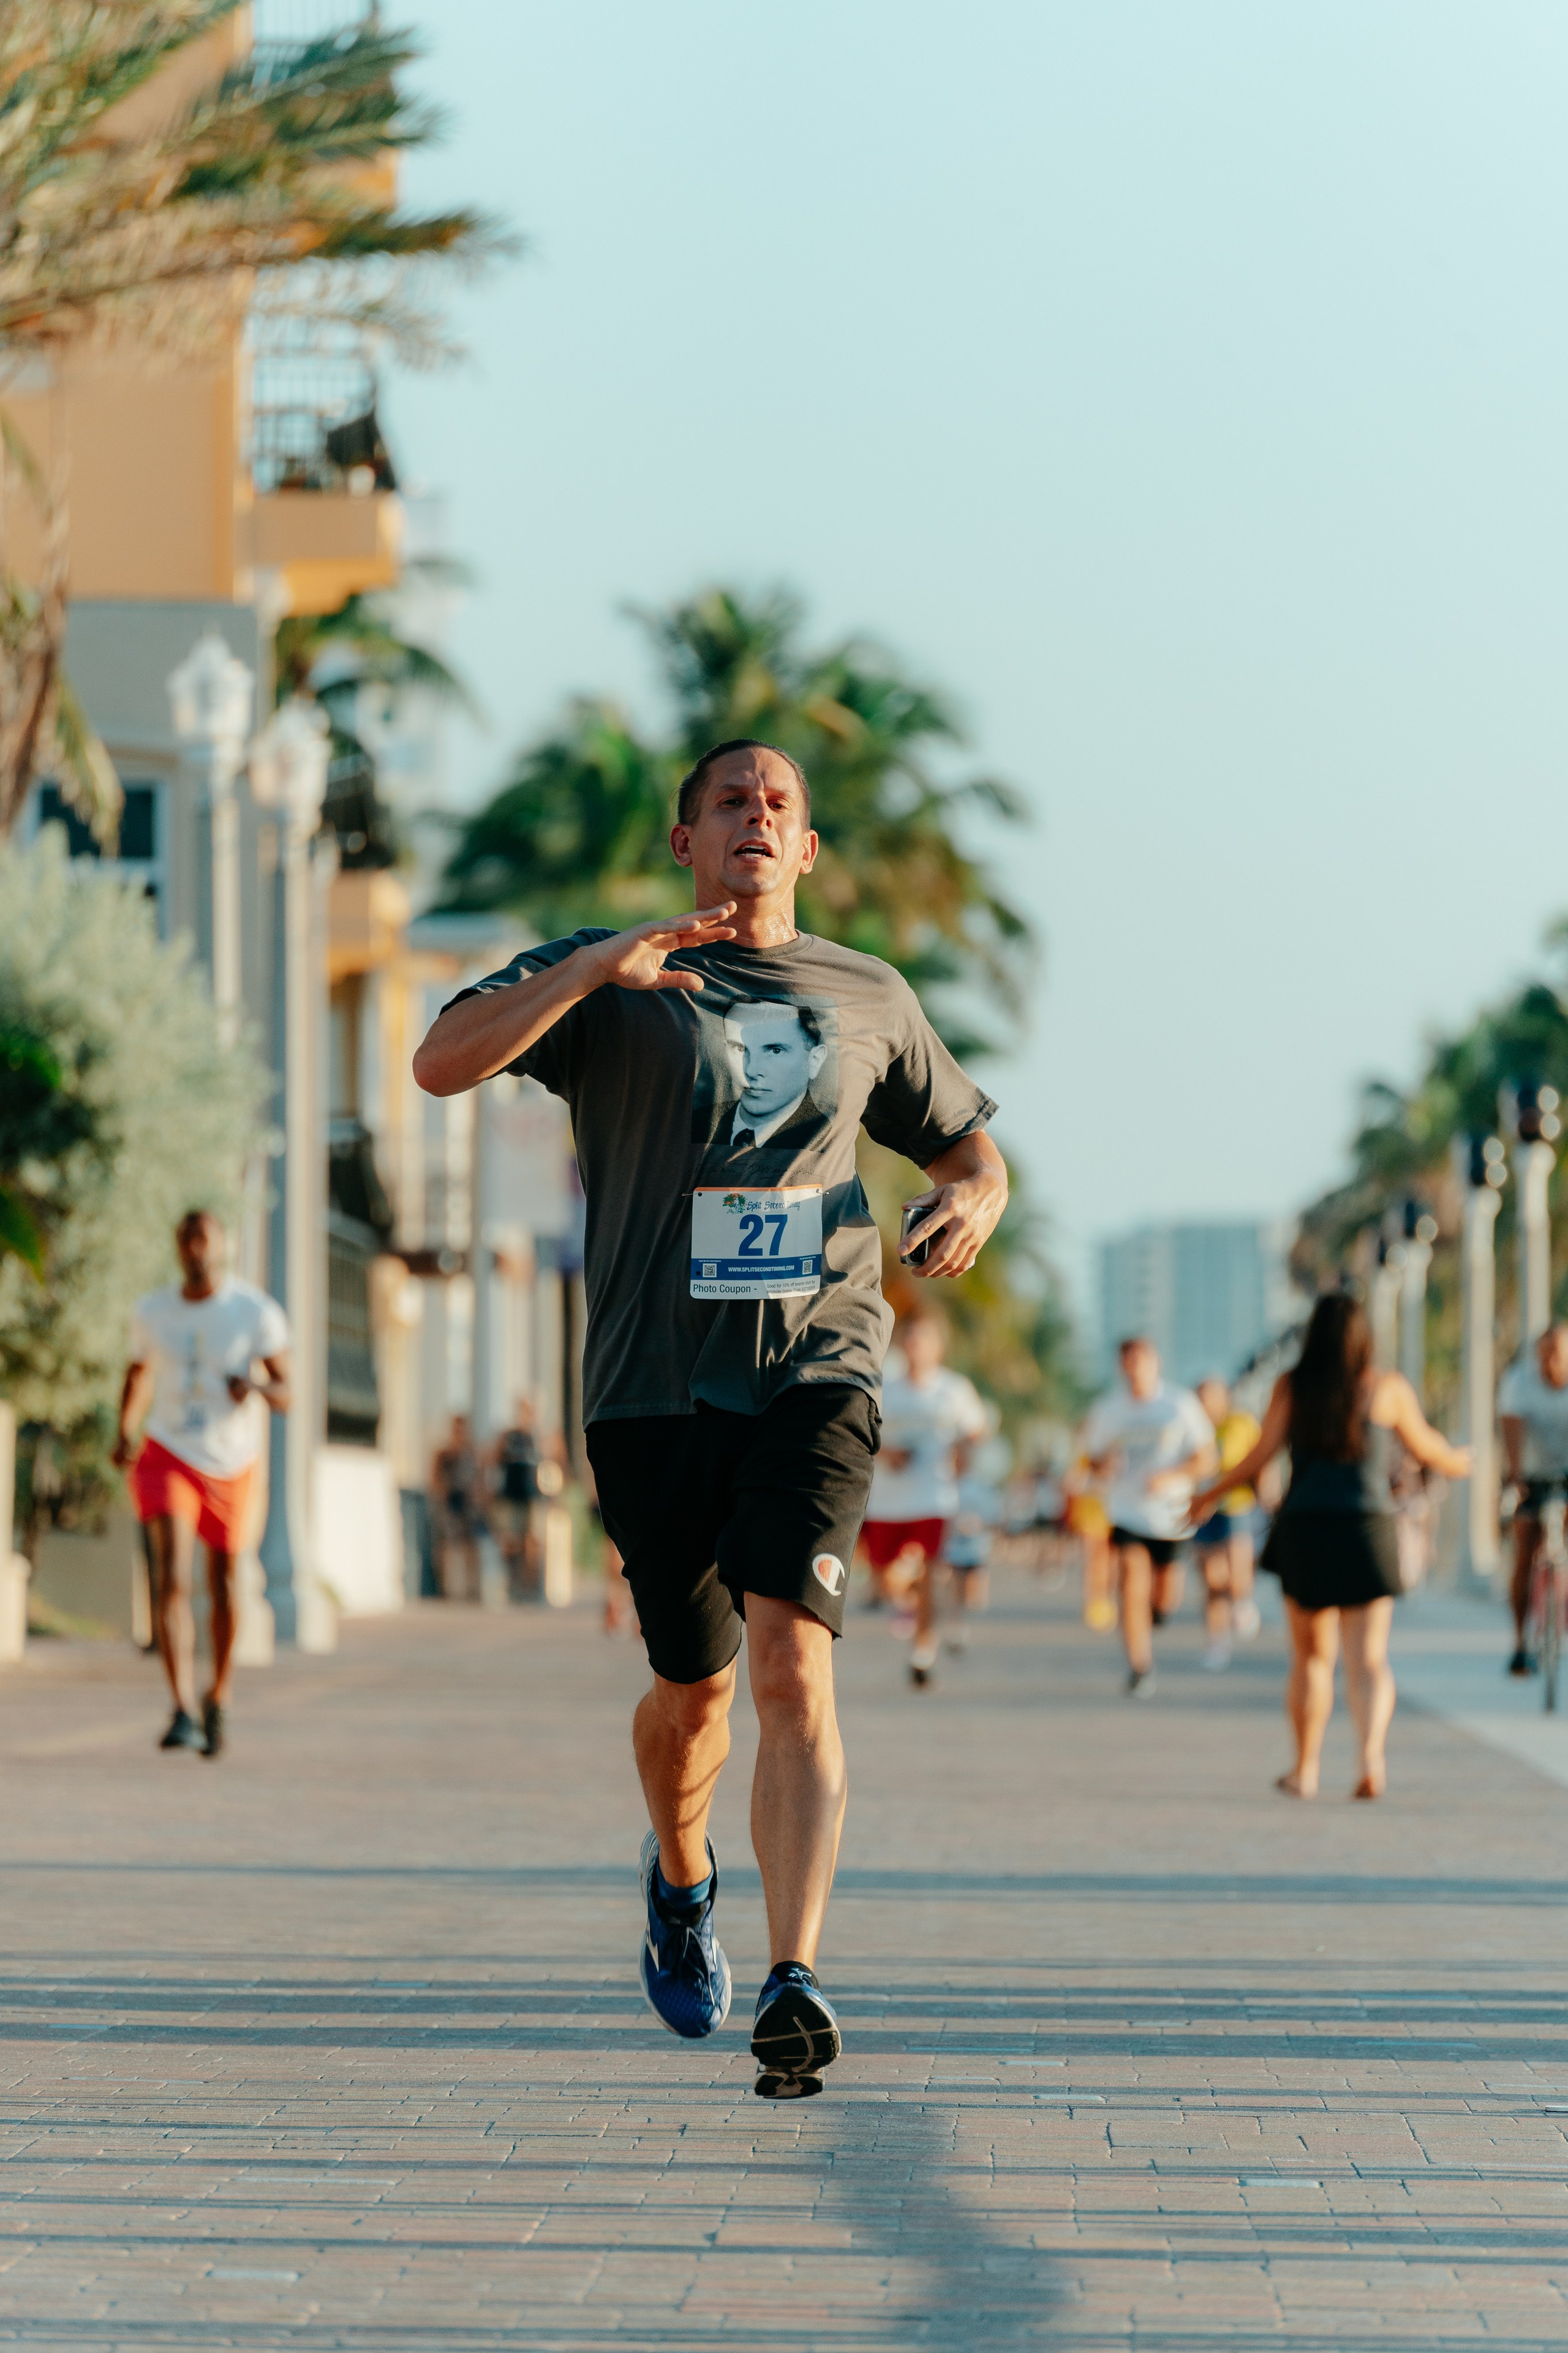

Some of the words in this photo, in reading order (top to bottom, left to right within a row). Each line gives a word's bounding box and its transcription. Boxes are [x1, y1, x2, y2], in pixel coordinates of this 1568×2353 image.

[747, 1201, 762, 1212] Split
[764, 1201, 785, 1210] Second
[738, 1214, 788, 1256] 27
[693, 1284, 717, 1293] Photo
[719, 1285, 751, 1294] Coupon
